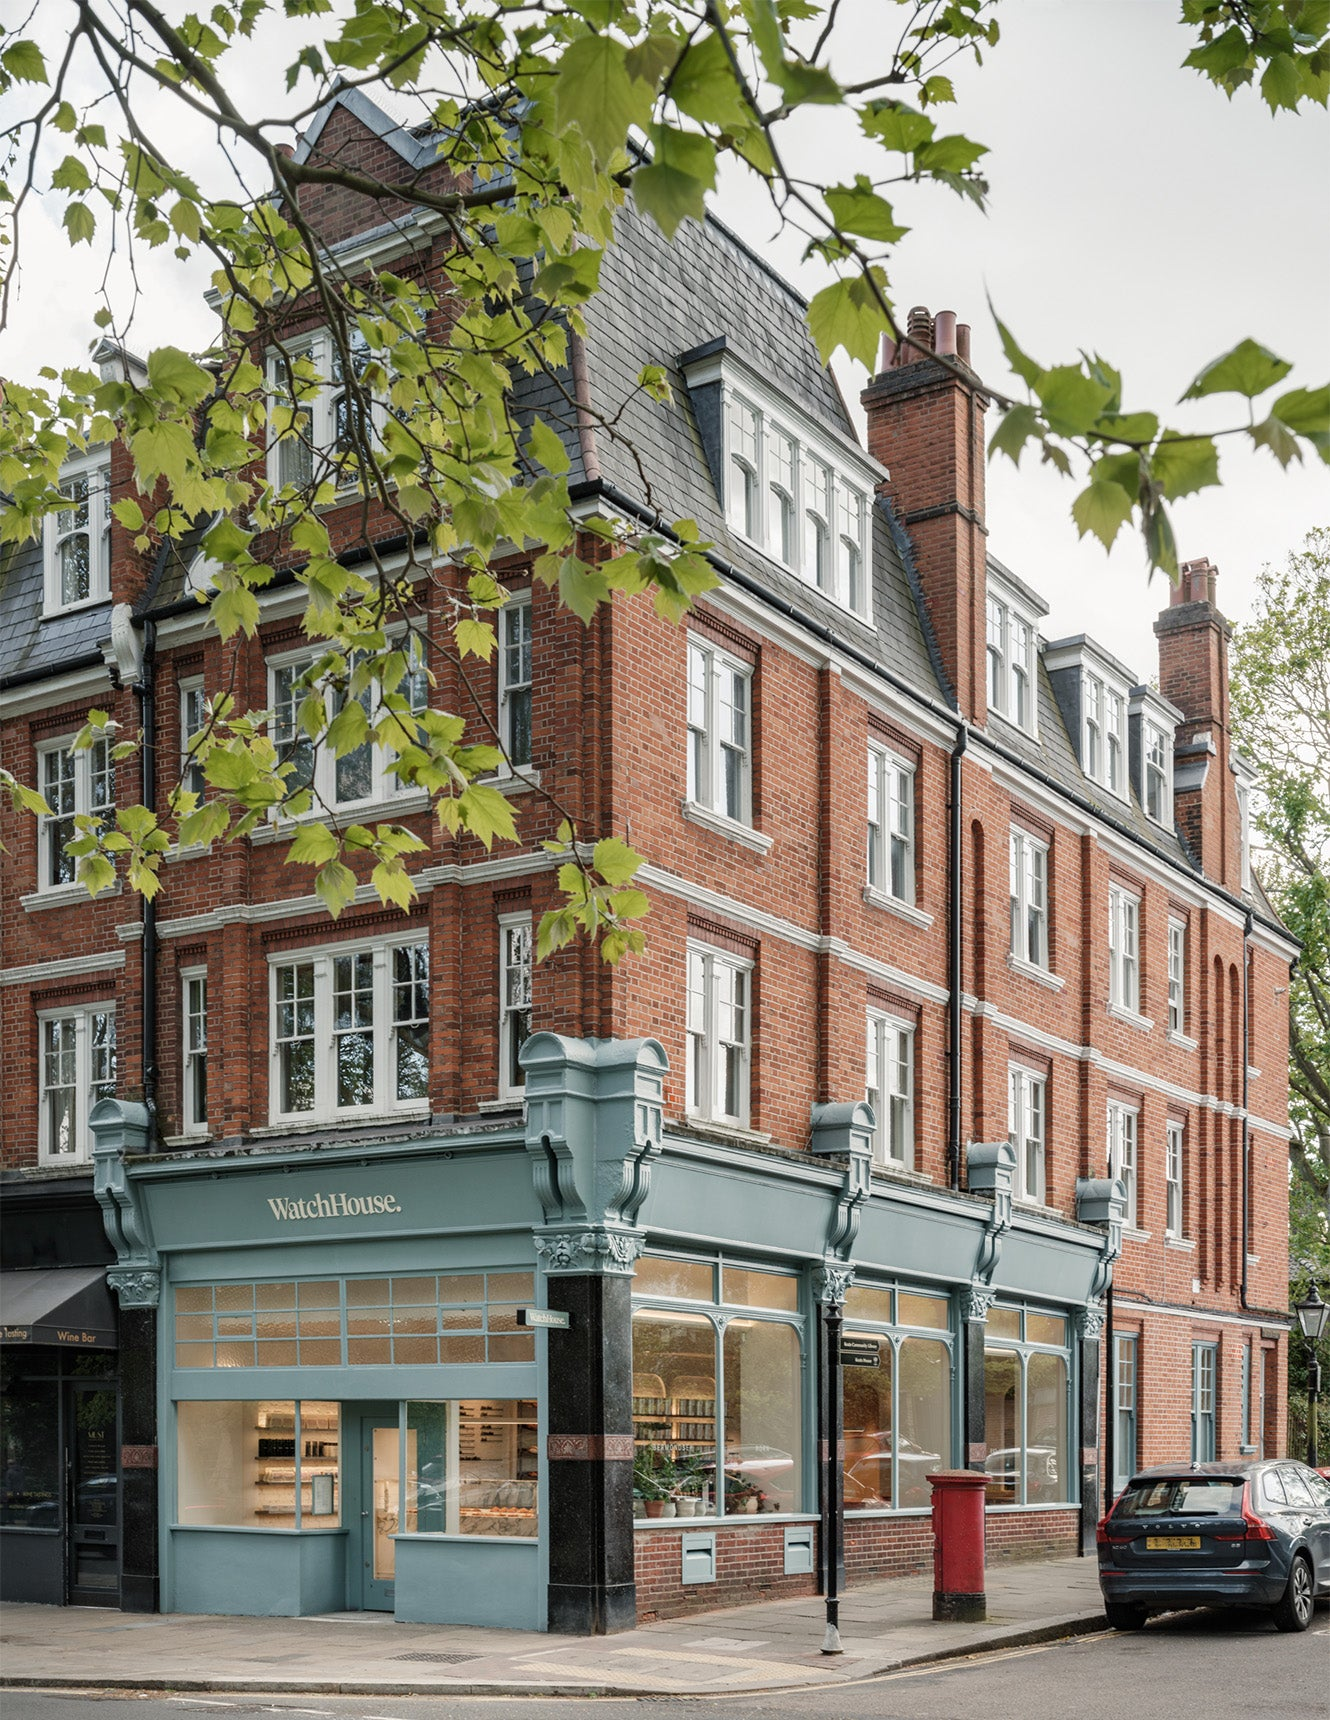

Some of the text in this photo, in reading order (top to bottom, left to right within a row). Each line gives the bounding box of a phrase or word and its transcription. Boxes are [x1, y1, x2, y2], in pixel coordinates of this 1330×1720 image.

[267, 1193, 402, 1221] WatchHouse.
[3, 1327, 28, 1340] Tasting
[57, 1331, 96, 1343] Wine Bar
